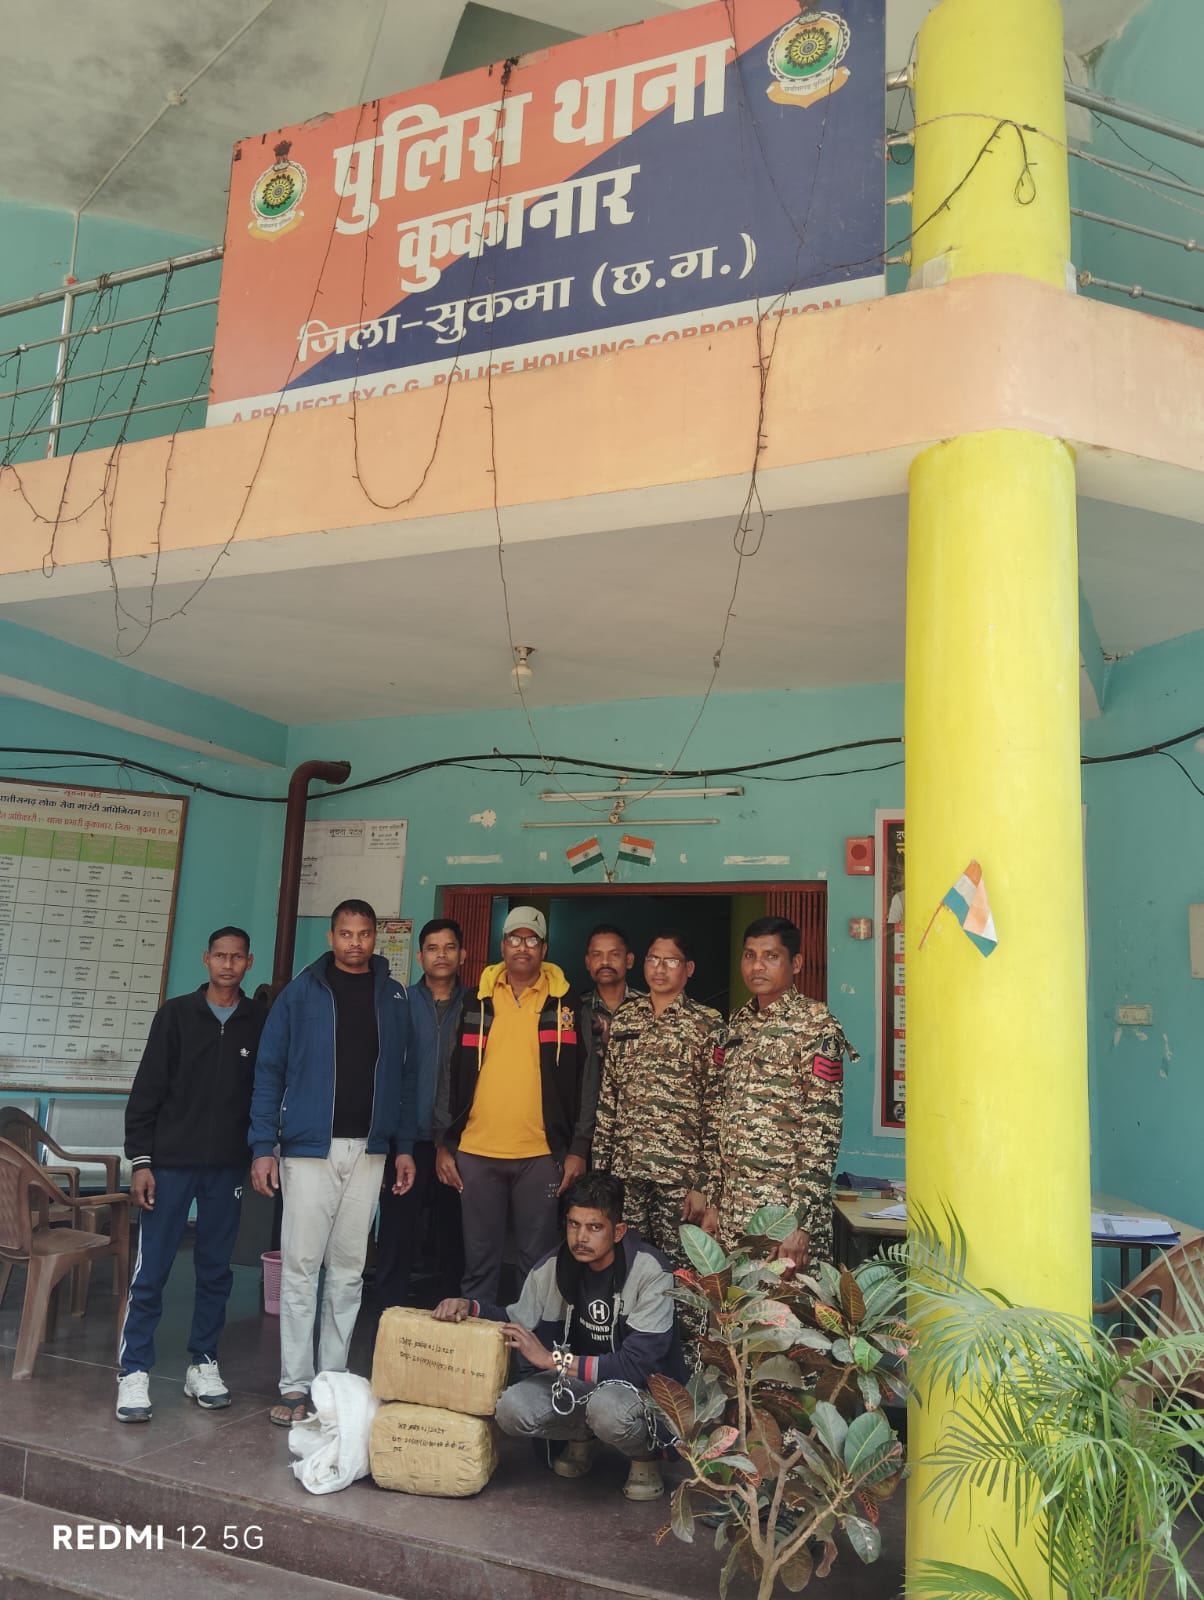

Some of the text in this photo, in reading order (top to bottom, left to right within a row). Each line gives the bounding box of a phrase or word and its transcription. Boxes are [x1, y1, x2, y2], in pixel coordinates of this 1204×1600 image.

[333, 38, 735, 236] पुलिस थाना
[397, 165, 640, 293] कुकानार
[592, 232, 757, 306] (छ.ग.)
[523, 339, 635, 369] HOUSING
